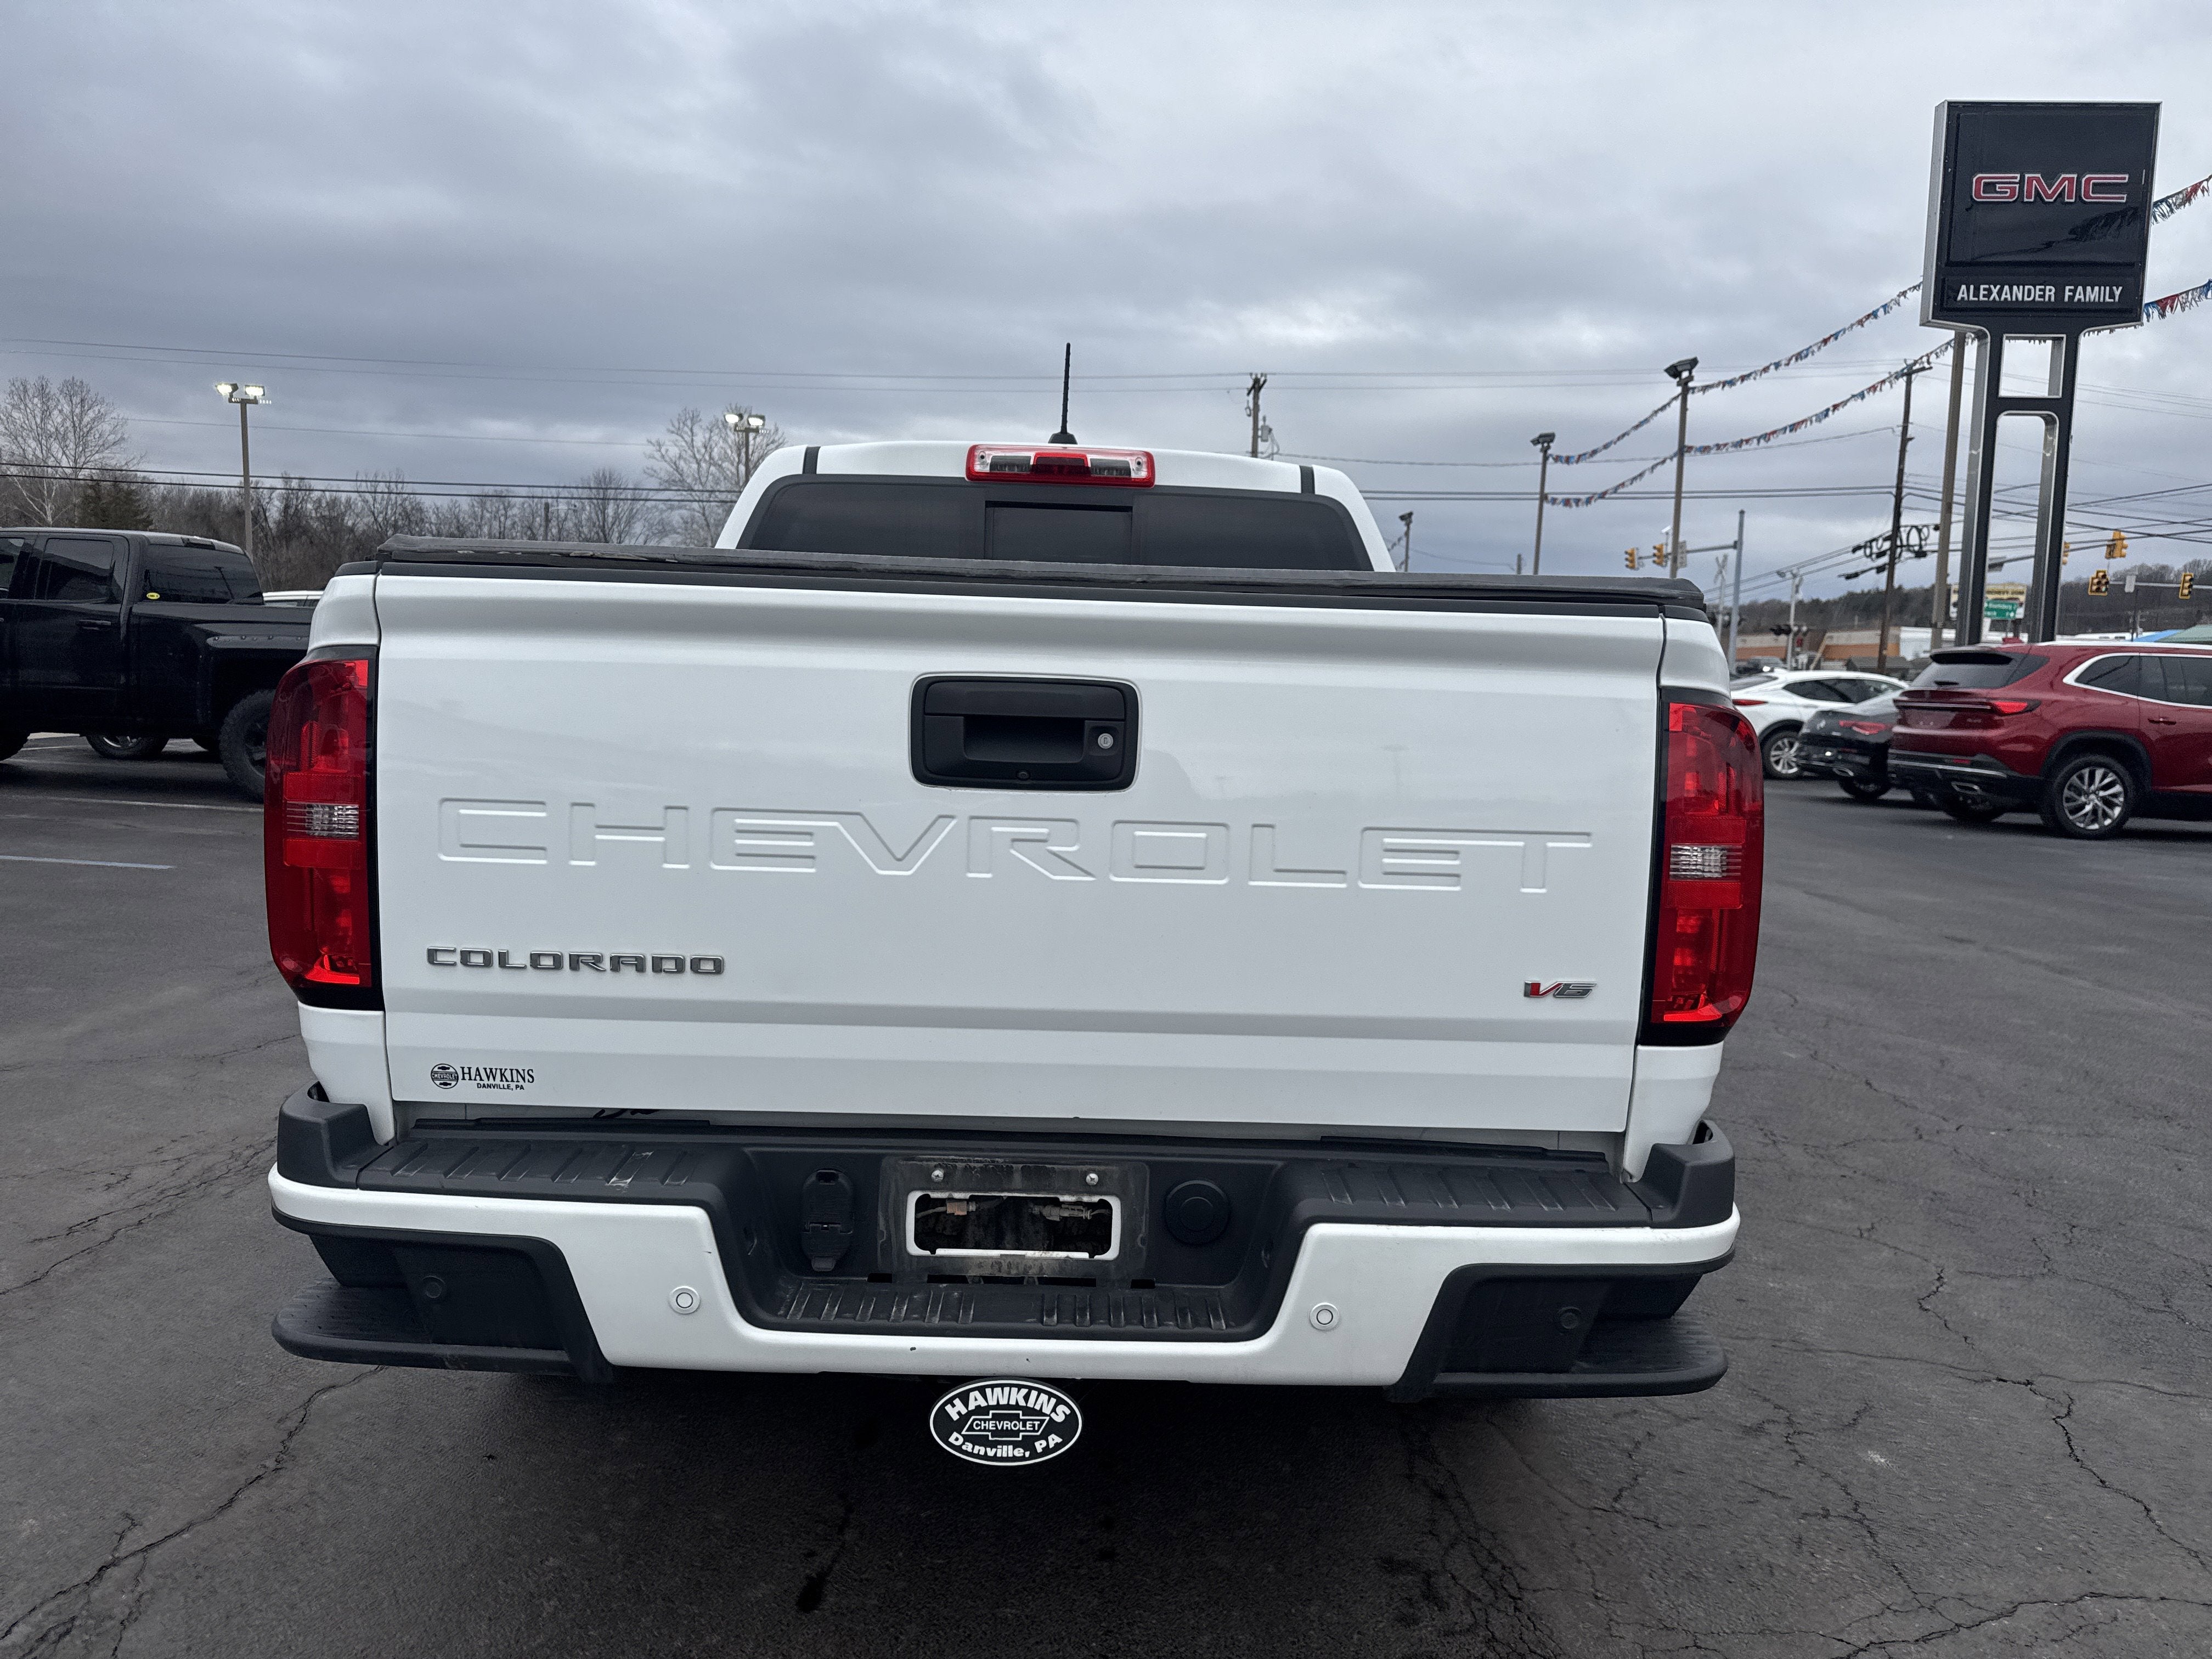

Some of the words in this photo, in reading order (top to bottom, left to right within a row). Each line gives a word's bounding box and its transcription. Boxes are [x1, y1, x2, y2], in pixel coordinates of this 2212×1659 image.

[1973, 173, 2129, 203] GMC
[1957, 285, 2056, 302] ALEXANDER
[2064, 285, 2123, 303] FAMILY
[438, 798, 1593, 894] CHEVROLET
[426, 946, 725, 974] COLORADO
[1523, 981, 1597, 998] V6
[460, 1066, 535, 1083] HAWKINS
[477, 1082, 514, 1091] DANVILLE,
[945, 1387, 1070, 1423] HAWKINS
[973, 1421, 1040, 1430] CHEVROLET
[948, 1432, 1030, 1457] Danville,
[1035, 1434, 1063, 1453] PA
